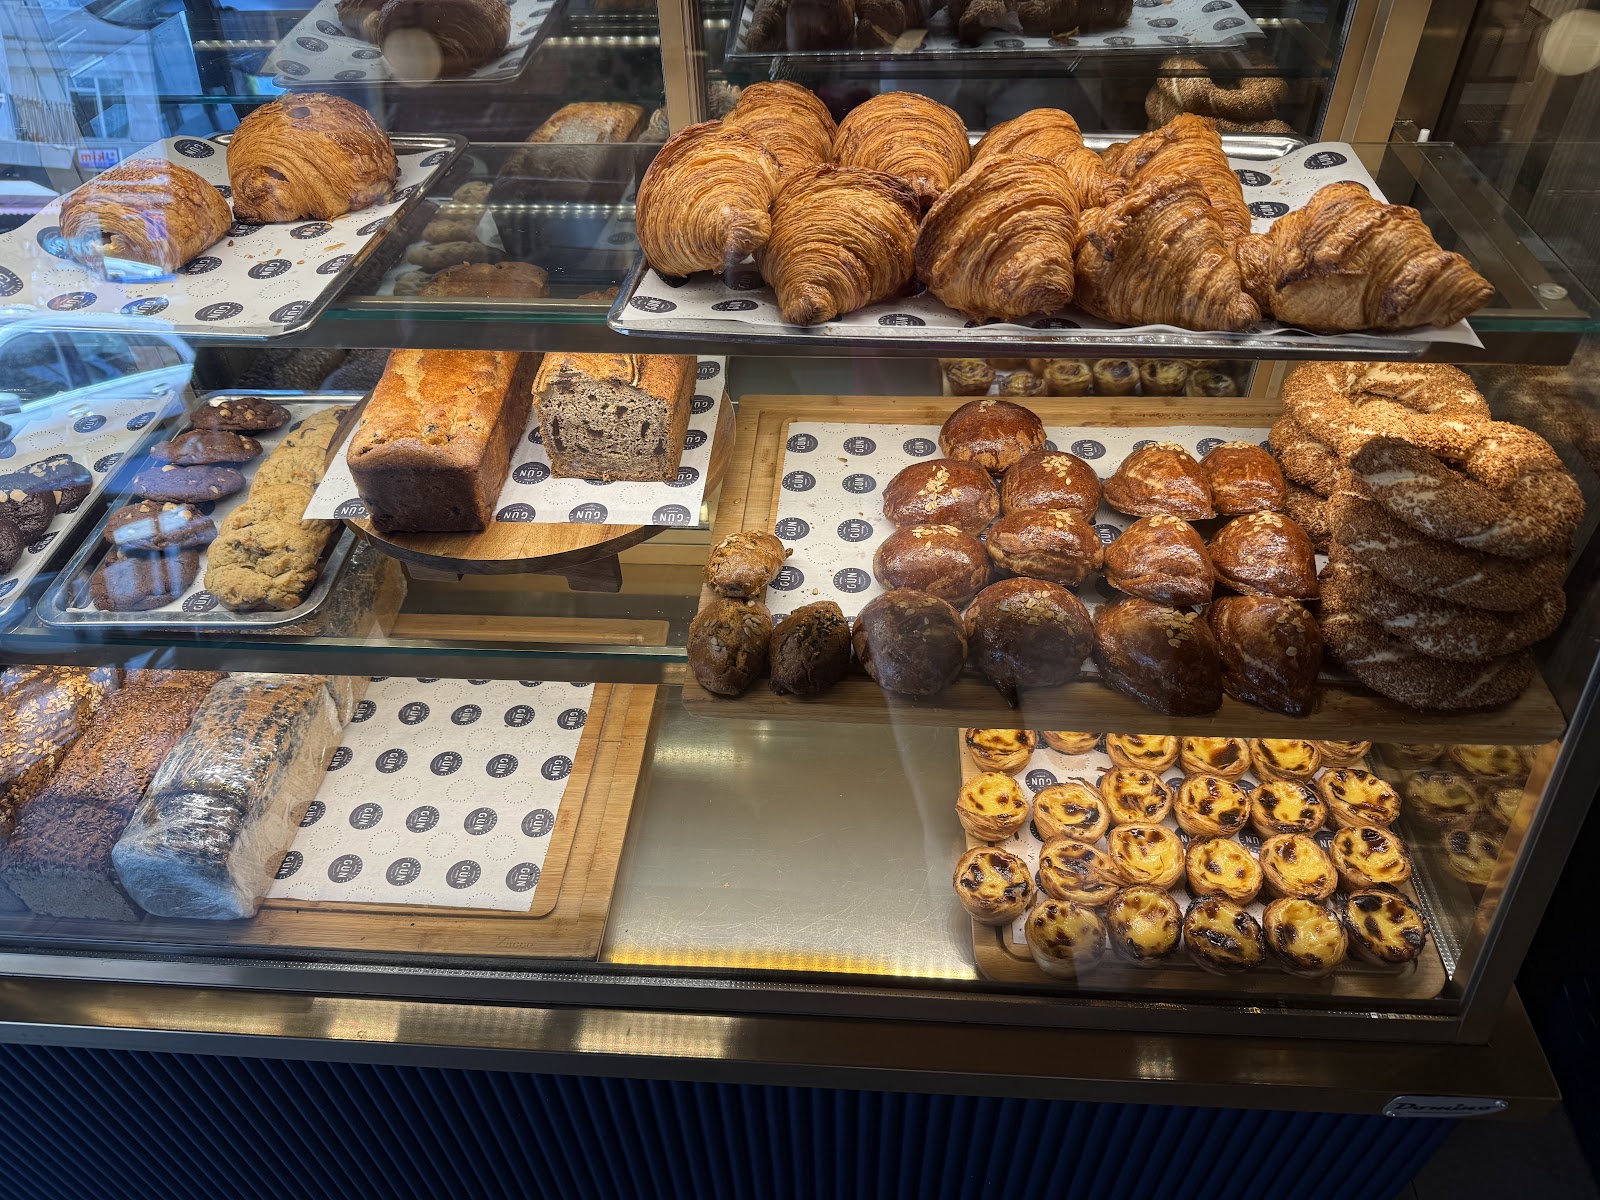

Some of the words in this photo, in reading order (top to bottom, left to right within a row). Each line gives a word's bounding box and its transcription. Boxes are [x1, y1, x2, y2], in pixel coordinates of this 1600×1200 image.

[207, 305, 230, 319] GÜN
[281, 305, 303, 320] GÜN
[795, 436, 807, 450] GÜN
[853, 439, 865, 453] GÜN
[912, 441, 924, 454] GÜN
[1081, 443, 1094, 457] GÜN
[519, 469, 544, 479] GÜN
[793, 474, 804, 489] GÜN
[852, 477, 864, 490] GÜN
[341, 506, 366, 516] GÜN
[503, 511, 529, 521] GÜN
[575, 510, 600, 521] GÜN
[659, 511, 684, 523] GÜN
[785, 521, 798, 536] GÜN
[848, 523, 860, 538] GÜN
[779, 571, 792, 586] GÜN
[844, 572, 858, 588] GÜN
[193, 594, 210, 610] GÜN
[356, 703, 370, 720] GÜN
[409, 703, 421, 721] GÜN
[460, 705, 473, 722] GÜN
[513, 706, 526, 723] GÜN
[566, 709, 579, 726] GÜN
[331, 750, 345, 769] GÜN
[386, 752, 399, 770] GÜN
[440, 754, 453, 772] GÜN
[497, 757, 509, 774] GÜN
[550, 759, 563, 776] GÜN
[1031, 777, 1052, 787] GÜN
[303, 805, 317, 823] GÜN
[359, 807, 374, 825] GÜN
[415, 810, 430, 828] GÜN
[473, 812, 487, 830] GÜN
[532, 814, 545, 832] GÜN
[279, 856, 294, 874] GÜN
[338, 859, 353, 878] GÜN
[394, 862, 410, 880] GÜN
[456, 865, 470, 884] GÜN
[516, 867, 531, 887] GÜN
[1394, 1102, 1491, 1112] Domino
